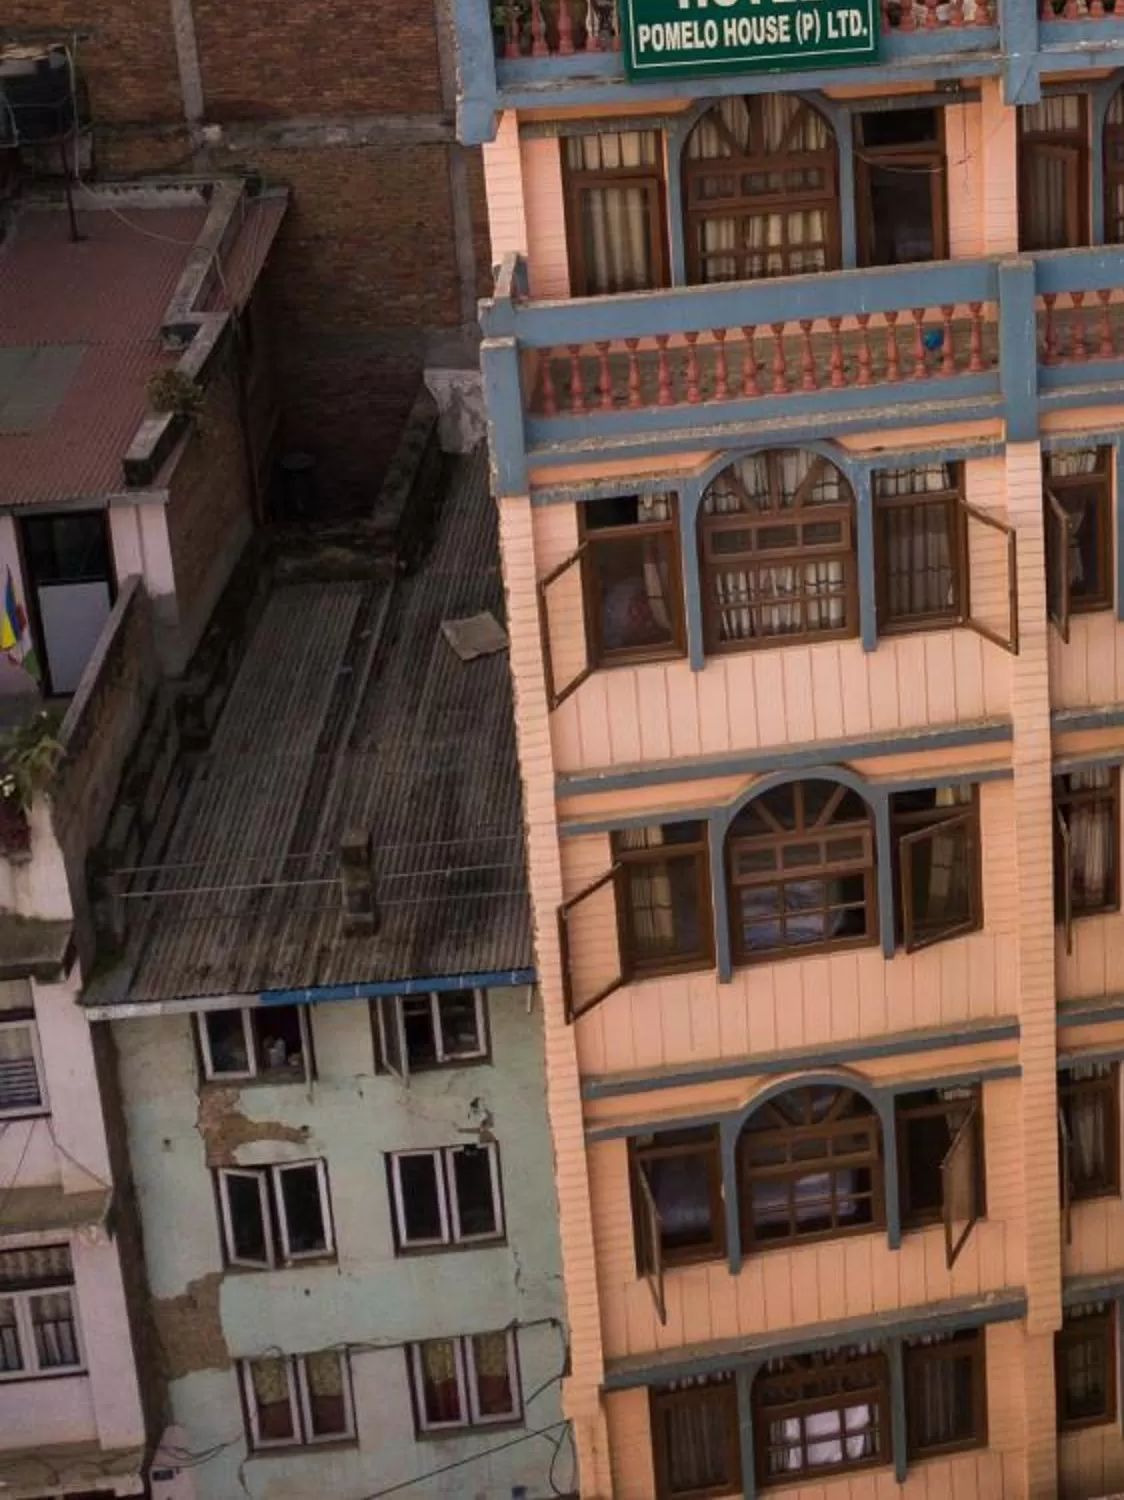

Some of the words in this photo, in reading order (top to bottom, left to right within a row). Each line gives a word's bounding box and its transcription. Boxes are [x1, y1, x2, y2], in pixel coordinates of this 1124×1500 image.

[637, 19, 719, 53] POMELO
[723, 13, 791, 47] HOUSE
[795, 8, 822, 45] (P)
[827, 9, 868, 40] LTD.
